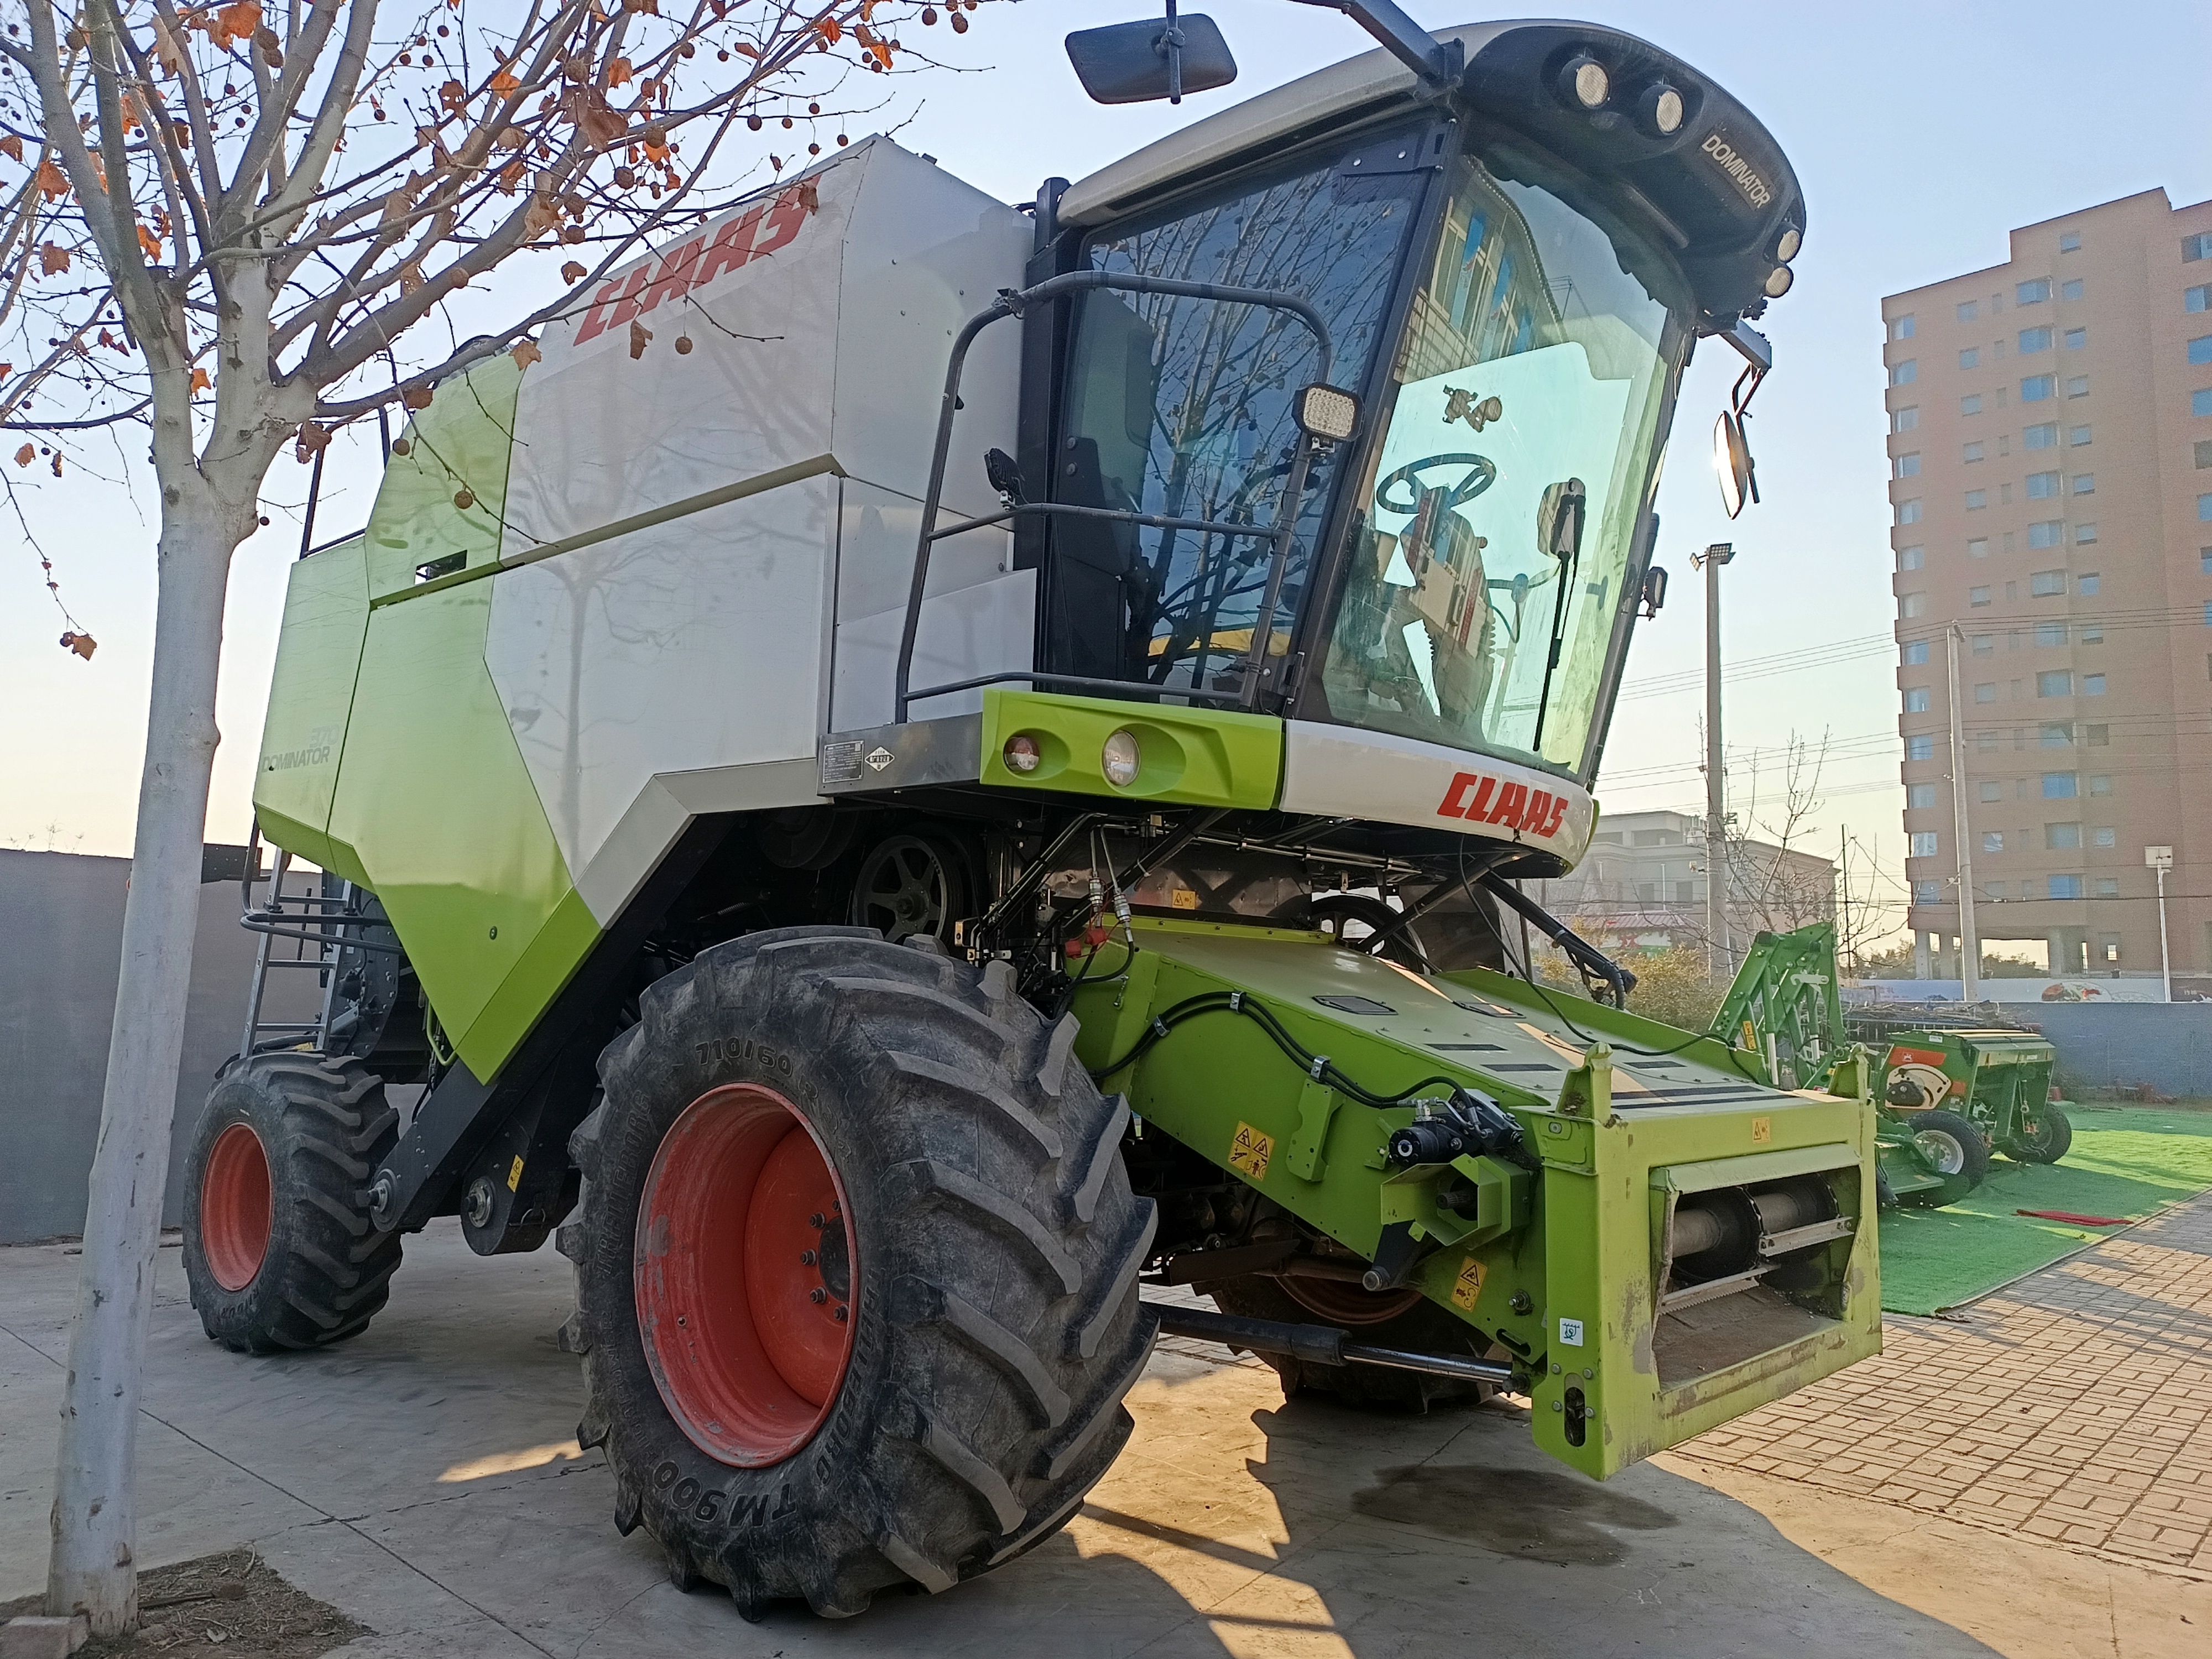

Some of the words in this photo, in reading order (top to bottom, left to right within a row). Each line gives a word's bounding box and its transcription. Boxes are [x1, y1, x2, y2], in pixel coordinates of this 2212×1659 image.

[1702, 134, 1770, 208] DOMINATOR
[573, 174, 823, 347] CLAAS
[262, 746, 330, 773] DOMINATOR
[1437, 772, 1568, 838] CLAAS
[695, 1036, 793, 1077] 710/60
[593, 1089, 651, 1275] TRELLEBORG
[816, 1267, 885, 1485] TRELLEBORG
